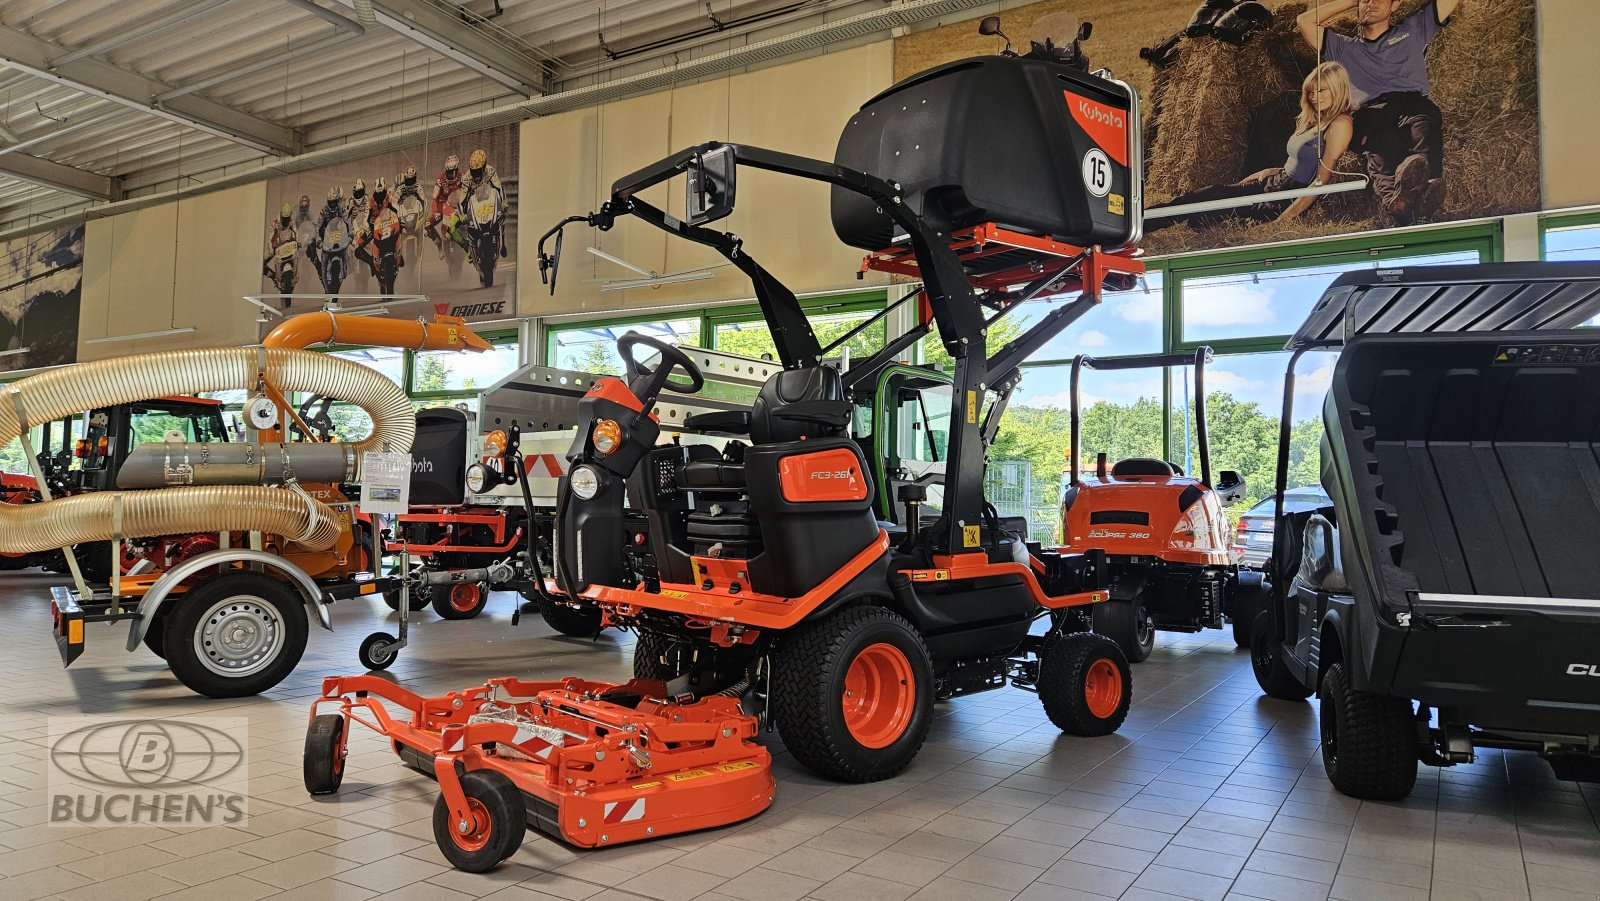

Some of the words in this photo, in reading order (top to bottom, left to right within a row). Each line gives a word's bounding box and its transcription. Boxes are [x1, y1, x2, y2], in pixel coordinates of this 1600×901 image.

[1080, 101, 1123, 129] Kubota
[1090, 157, 1106, 188] 15
[412, 456, 433, 473] bota
